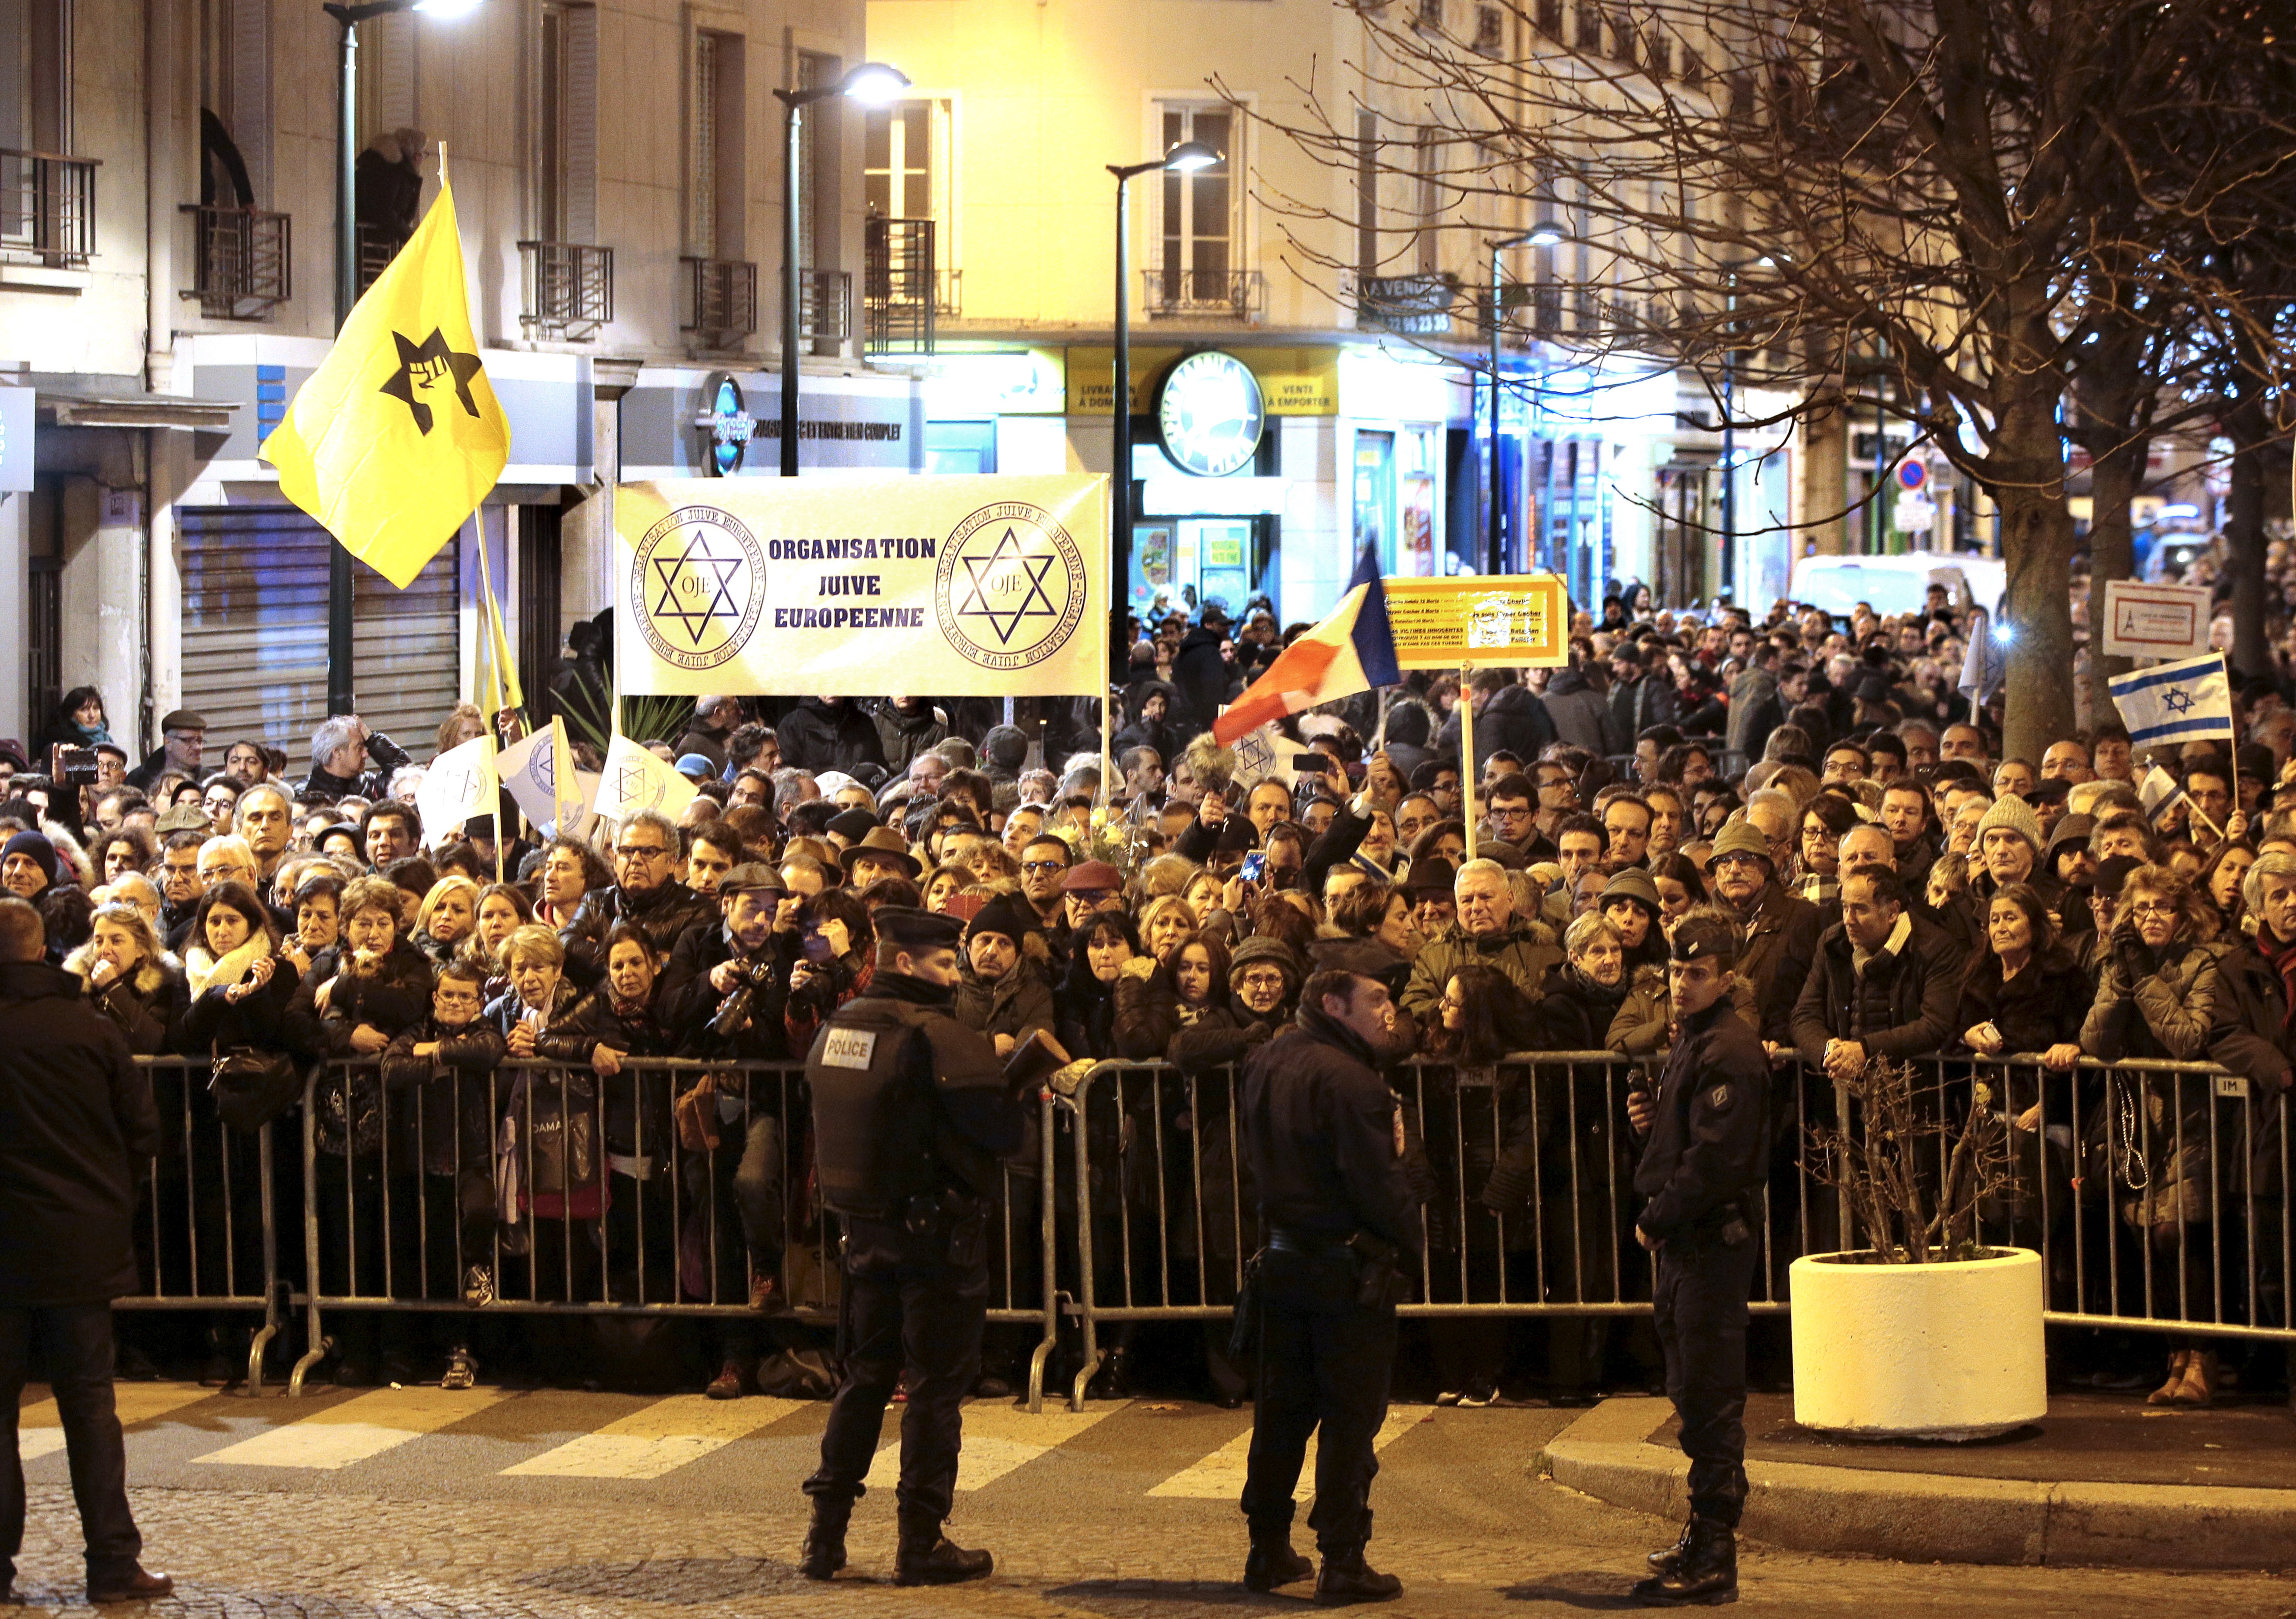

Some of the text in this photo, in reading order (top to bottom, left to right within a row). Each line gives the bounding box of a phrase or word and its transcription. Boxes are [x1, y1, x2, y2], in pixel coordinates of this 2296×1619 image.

[1278, 397, 1330, 406] EMPORTER
[688, 509, 718, 521] JUIVE
[769, 538, 935, 560] ORGANISATION
[939, 509, 991, 583] ORGANISATION
[997, 505, 1032, 519] JUIVE
[682, 576, 711, 598] OJE
[818, 575, 881, 596] JUIVE
[991, 574, 1022, 596] OJE
[774, 607, 924, 629] EUROPEENNE
[678, 654, 709, 667] JUIVE
[983, 653, 1019, 667] JUIVE
[827, 1039, 868, 1057] POLICE
